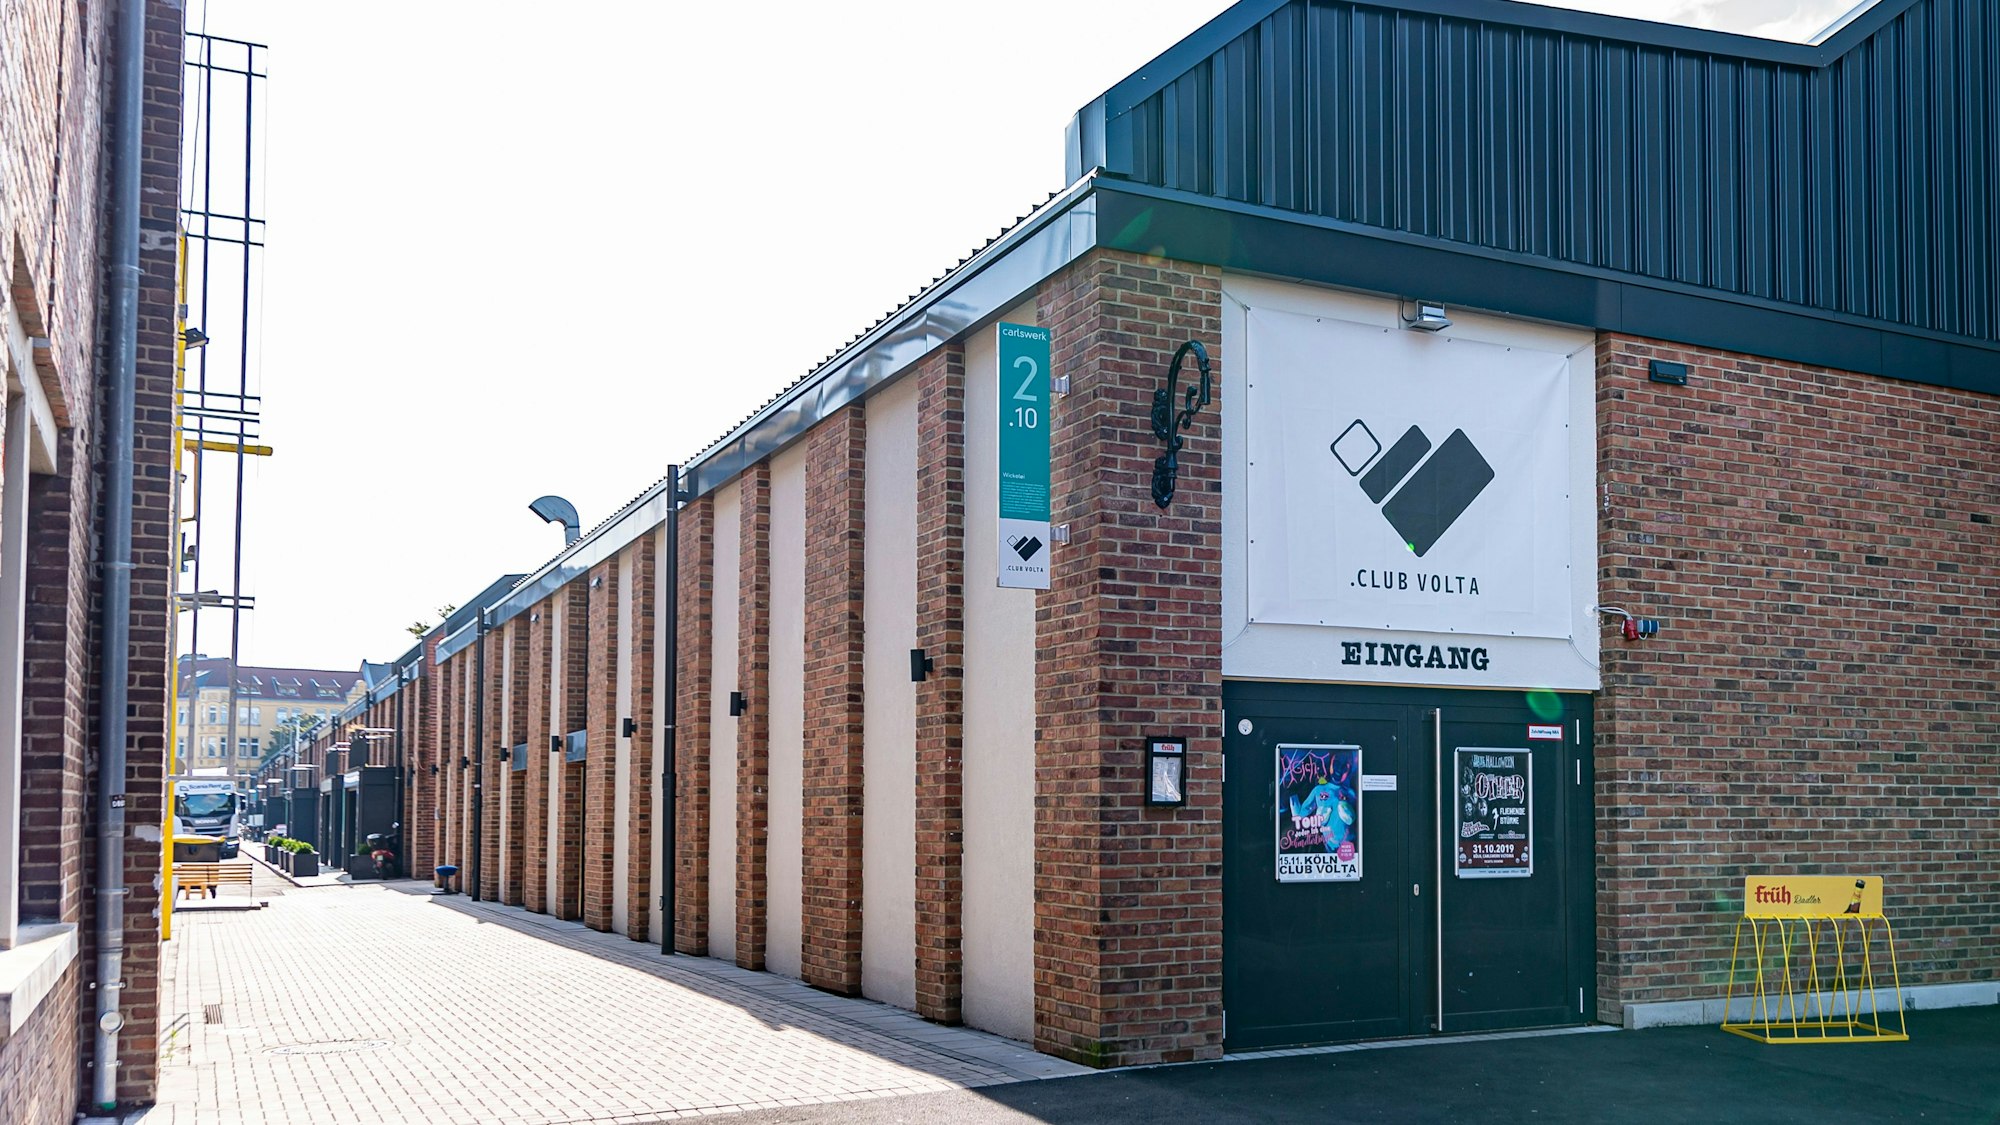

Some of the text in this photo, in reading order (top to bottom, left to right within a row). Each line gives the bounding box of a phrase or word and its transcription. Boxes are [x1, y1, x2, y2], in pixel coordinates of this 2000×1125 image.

[1002, 328, 1047, 341] carlswerk
[1013, 355, 1038, 402] 2
[1009, 407, 1038, 429] .10
[1350, 569, 1480, 595] .CLUB VOLTA
[1341, 641, 1490, 671] EINGANG
[1473, 844, 1515, 853] 31.10.2019
[1279, 857, 1302, 865] 15.11.
[1305, 854, 1338, 865] KÖLN
[1279, 864, 1357, 875] CLUB VOLTA
[1793, 895, 1822, 904] Radler
